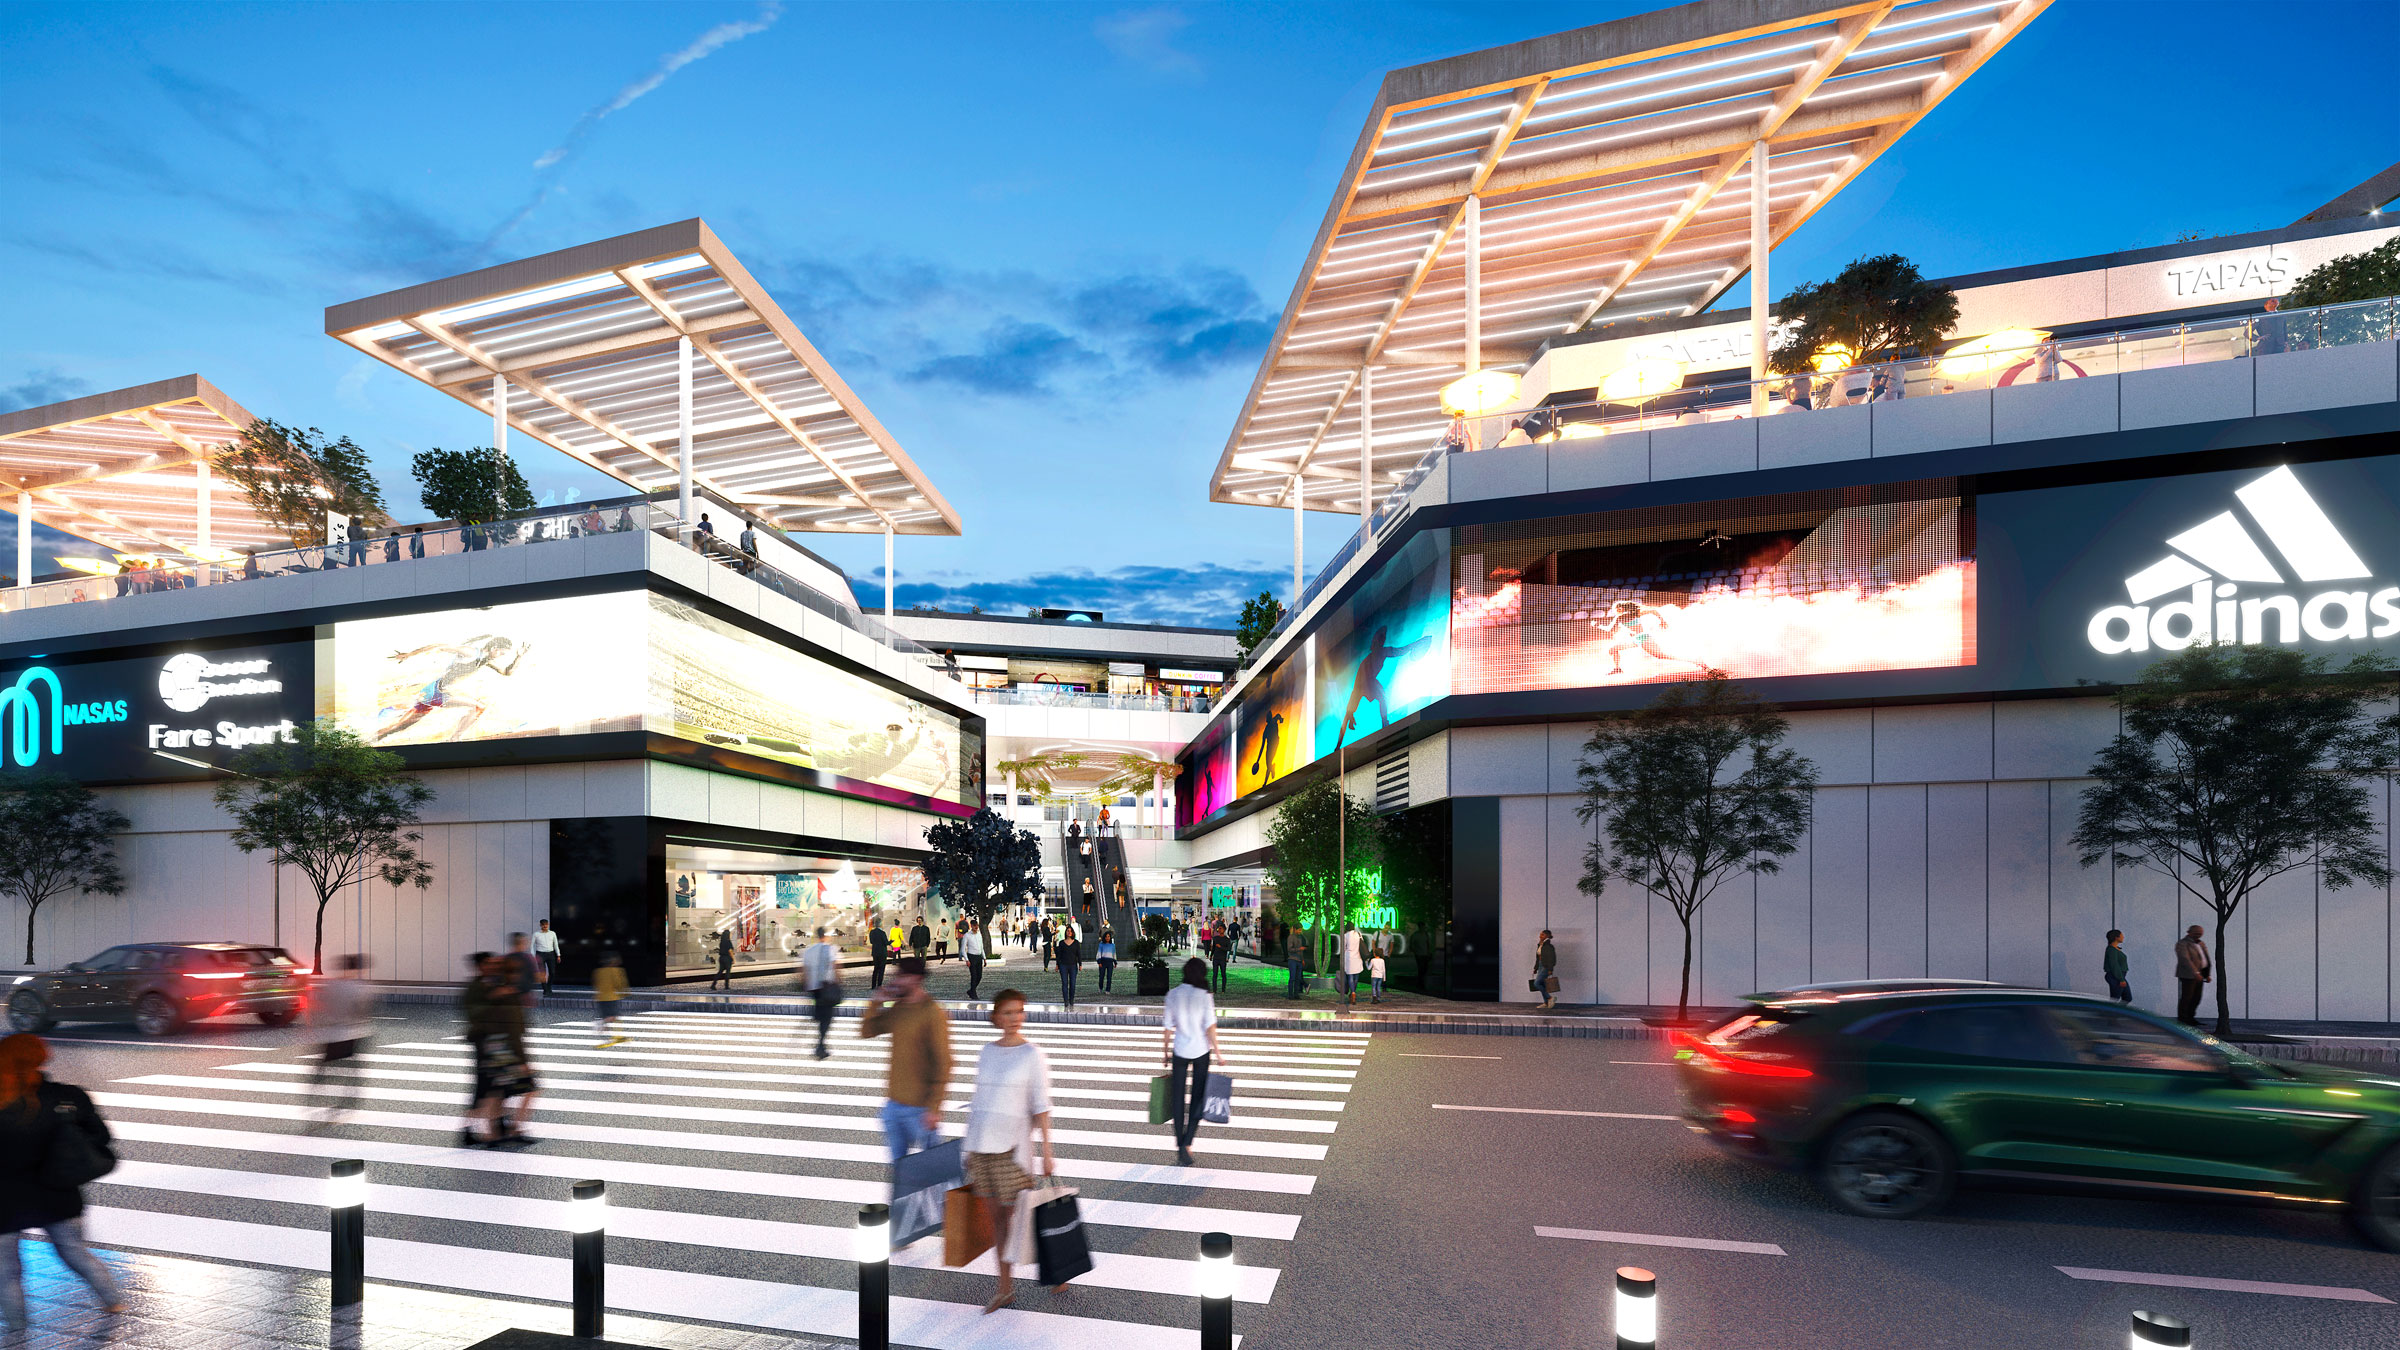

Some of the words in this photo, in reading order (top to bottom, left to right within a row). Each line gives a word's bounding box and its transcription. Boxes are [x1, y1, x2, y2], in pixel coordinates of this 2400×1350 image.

[2167, 257, 2289, 296] TAPAS
[2087, 579, 2400, 655] adinas
[63, 700, 128, 726] NASAS
[149, 724, 212, 749] Fare
[216, 719, 299, 750] Sport
